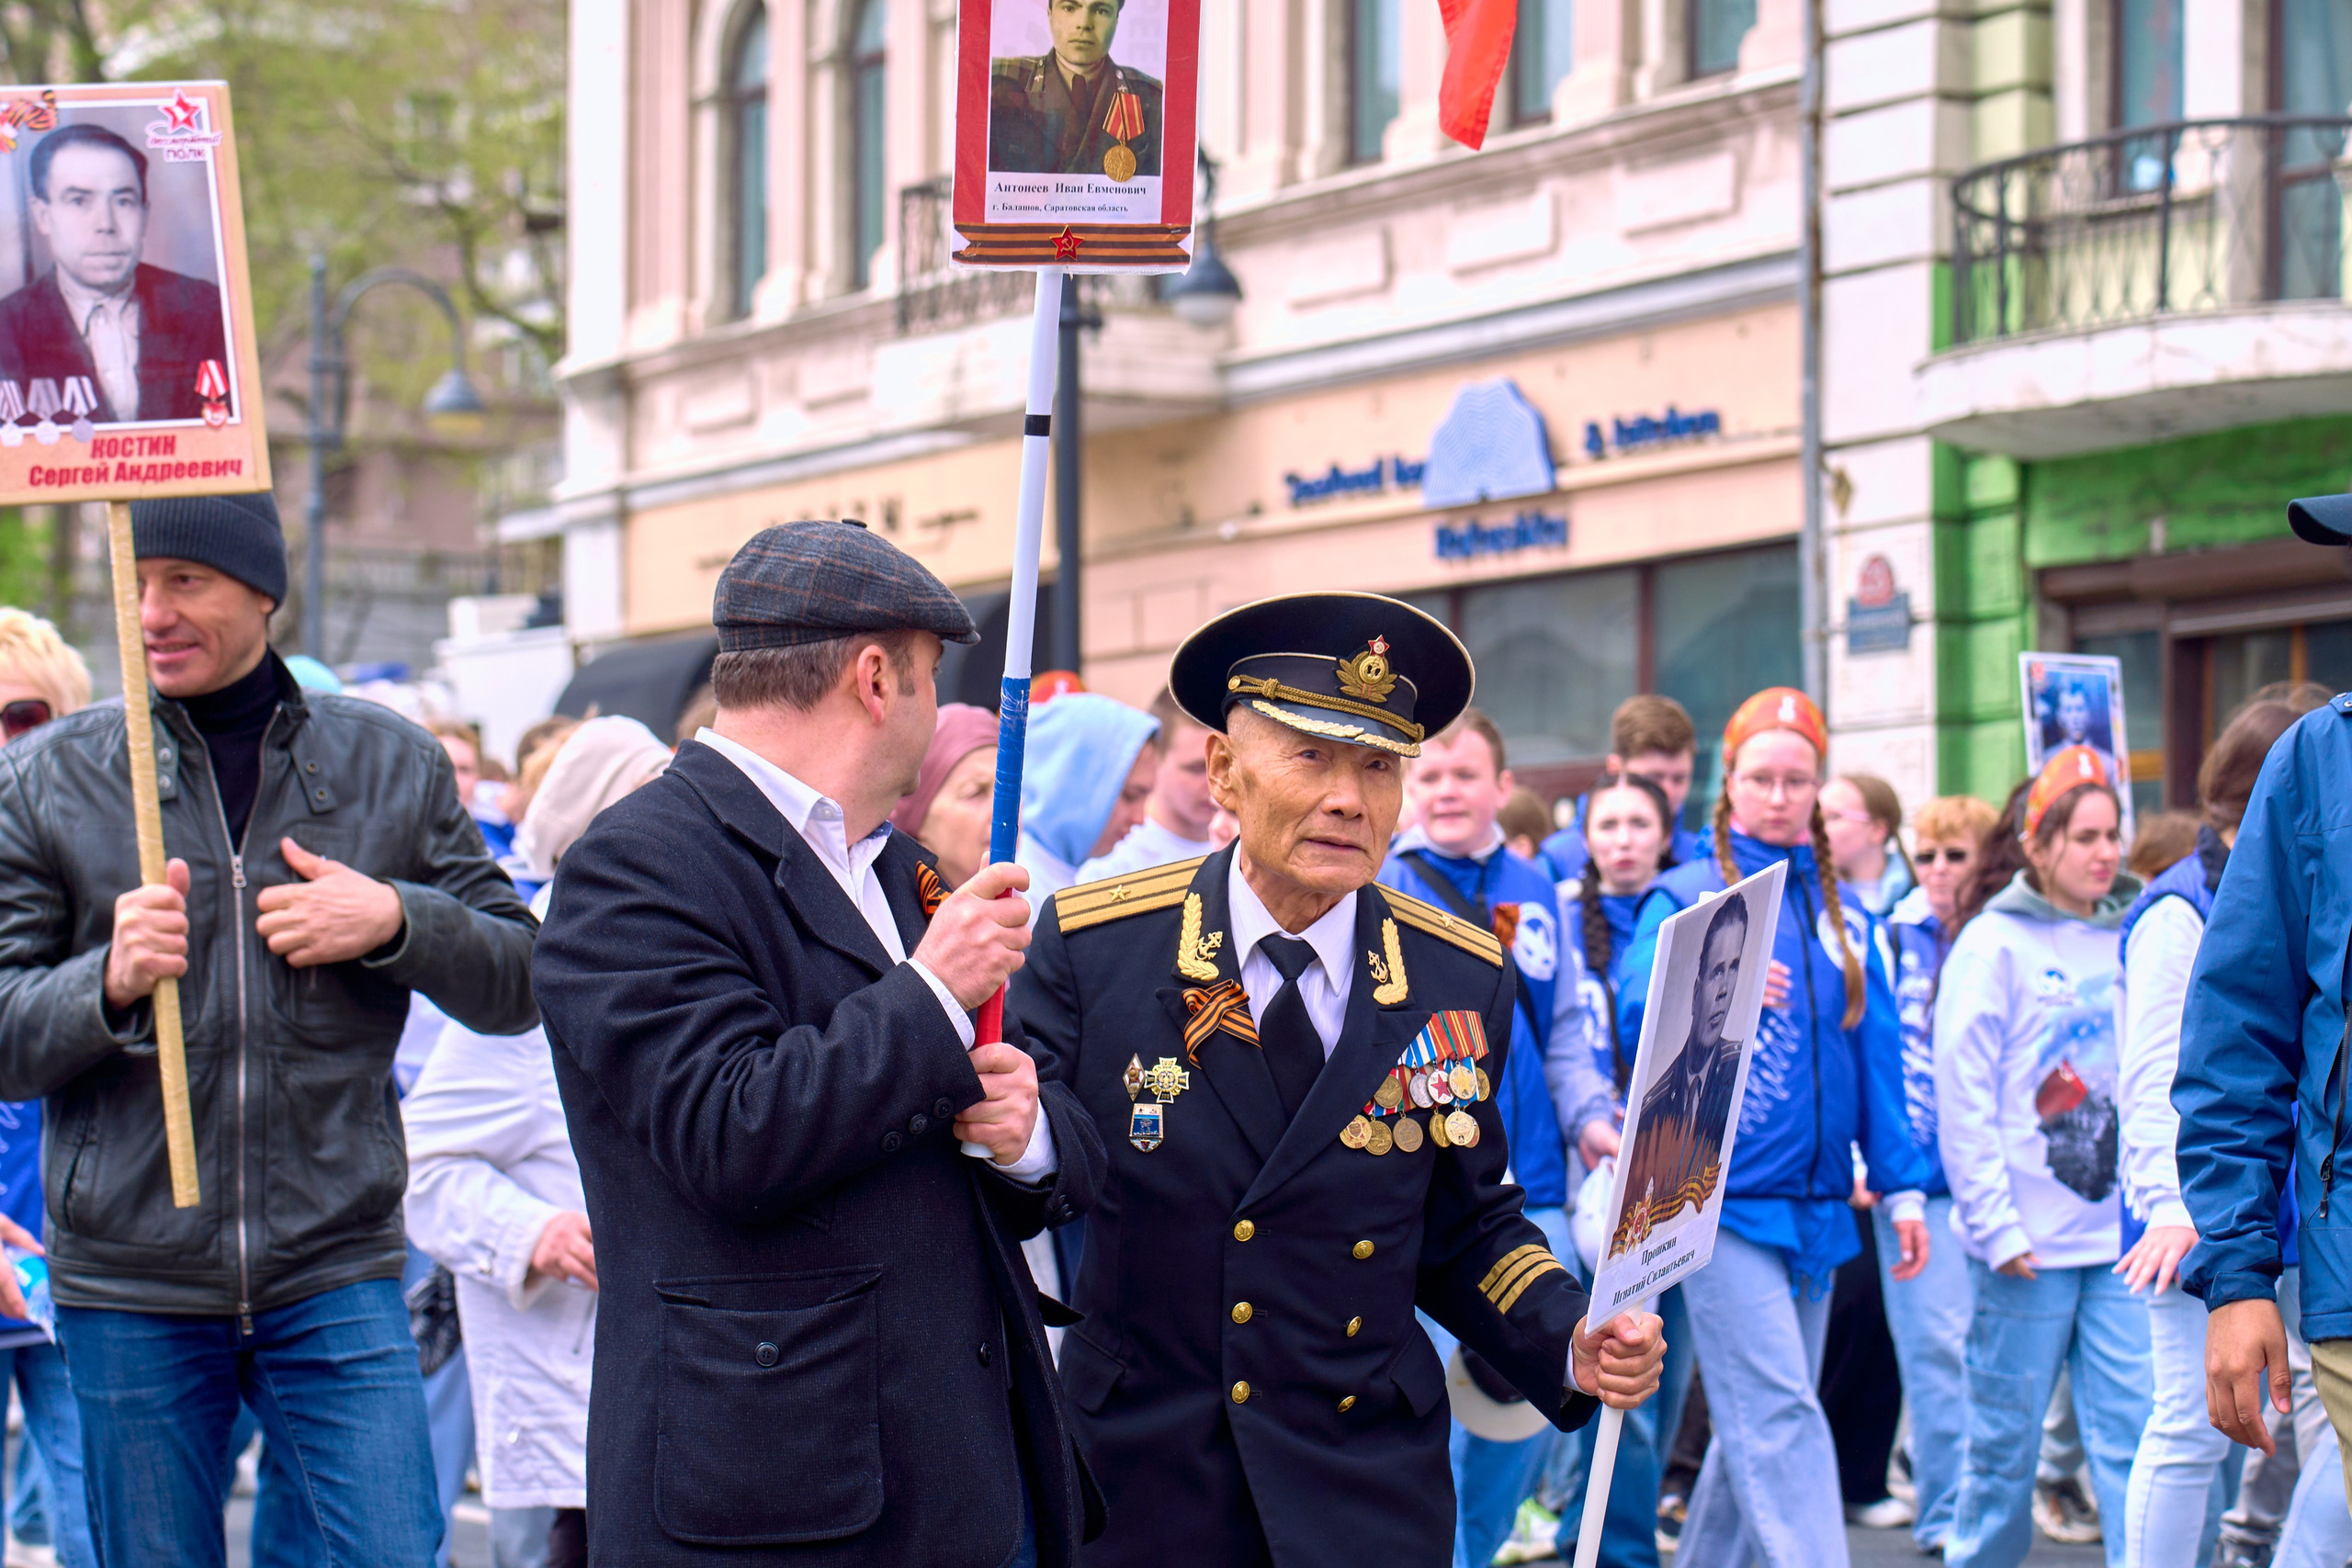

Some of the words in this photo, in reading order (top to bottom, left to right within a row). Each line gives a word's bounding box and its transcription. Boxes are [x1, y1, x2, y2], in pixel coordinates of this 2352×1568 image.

[166, 149, 205, 160] ПОЛК
[994, 183, 1049, 194] Антонеев
[1055, 183, 1083, 194] Иван
[1087, 184, 1147, 196] Евменович
[1001, 203, 1042, 212] Балашов,
[1044, 204, 1096, 213] Саратовская
[1097, 204, 1128, 213] область
[90, 435, 176, 458] КОСТИН
[28, 462, 109, 487] Сергей
[114, 459, 243, 484] Андреевич
[1641, 1236, 1677, 1266] Прошкин
[1612, 1276, 1646, 1306] Игнатий
[1646, 1249, 1695, 1285] Силантьевич
